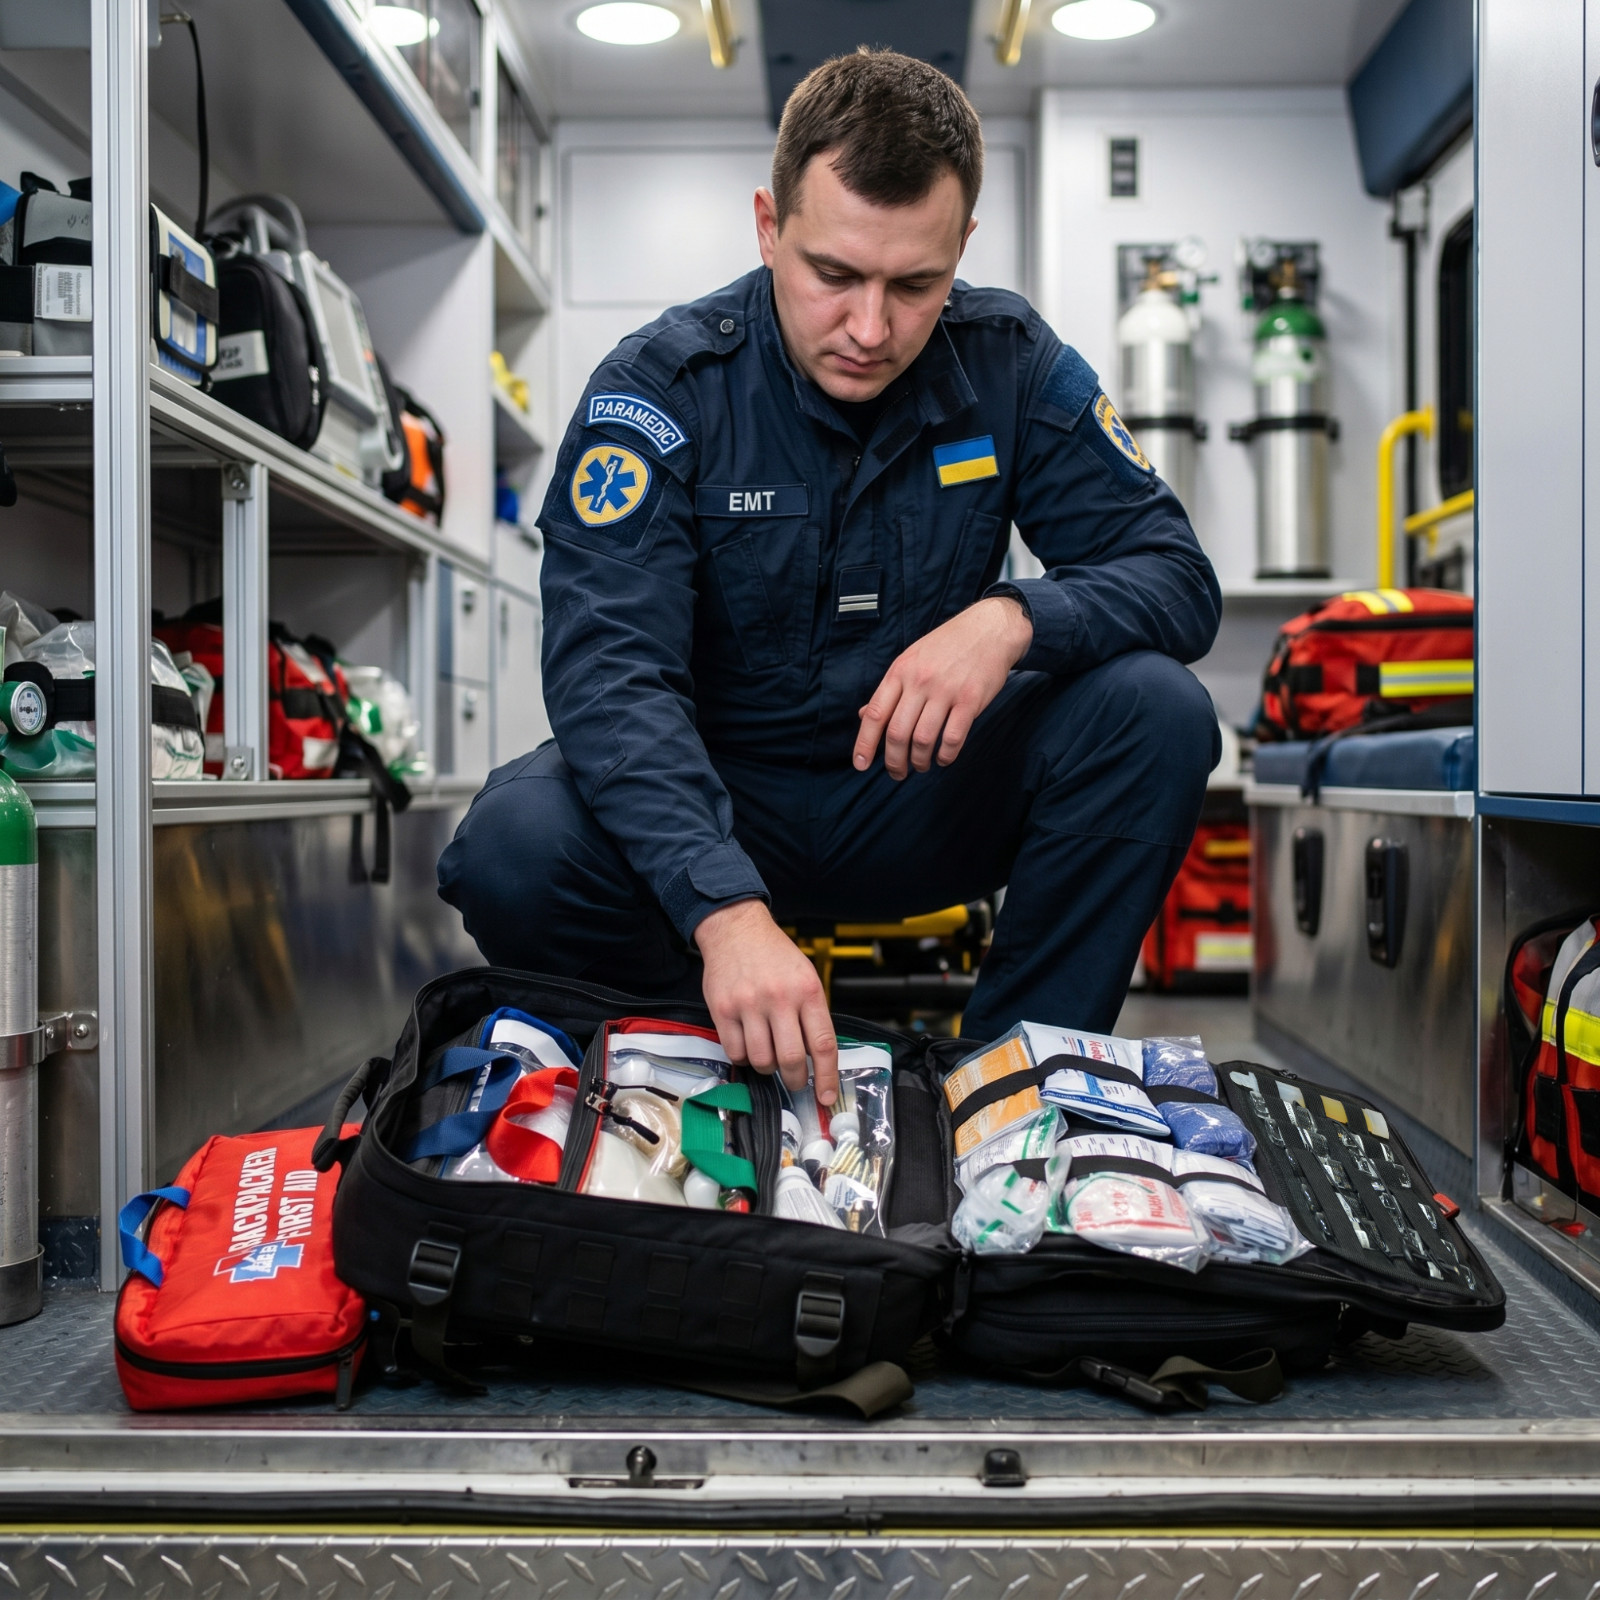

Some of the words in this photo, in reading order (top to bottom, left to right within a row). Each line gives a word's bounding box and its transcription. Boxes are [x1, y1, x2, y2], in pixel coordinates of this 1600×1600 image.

[594, 401, 676, 445] PARAMEDIC
[729, 491, 775, 512] EMT
[228, 1147, 278, 1253] BACKPACKER
[282, 1169, 319, 1192] AID
[275, 1196, 315, 1241] FIRST
